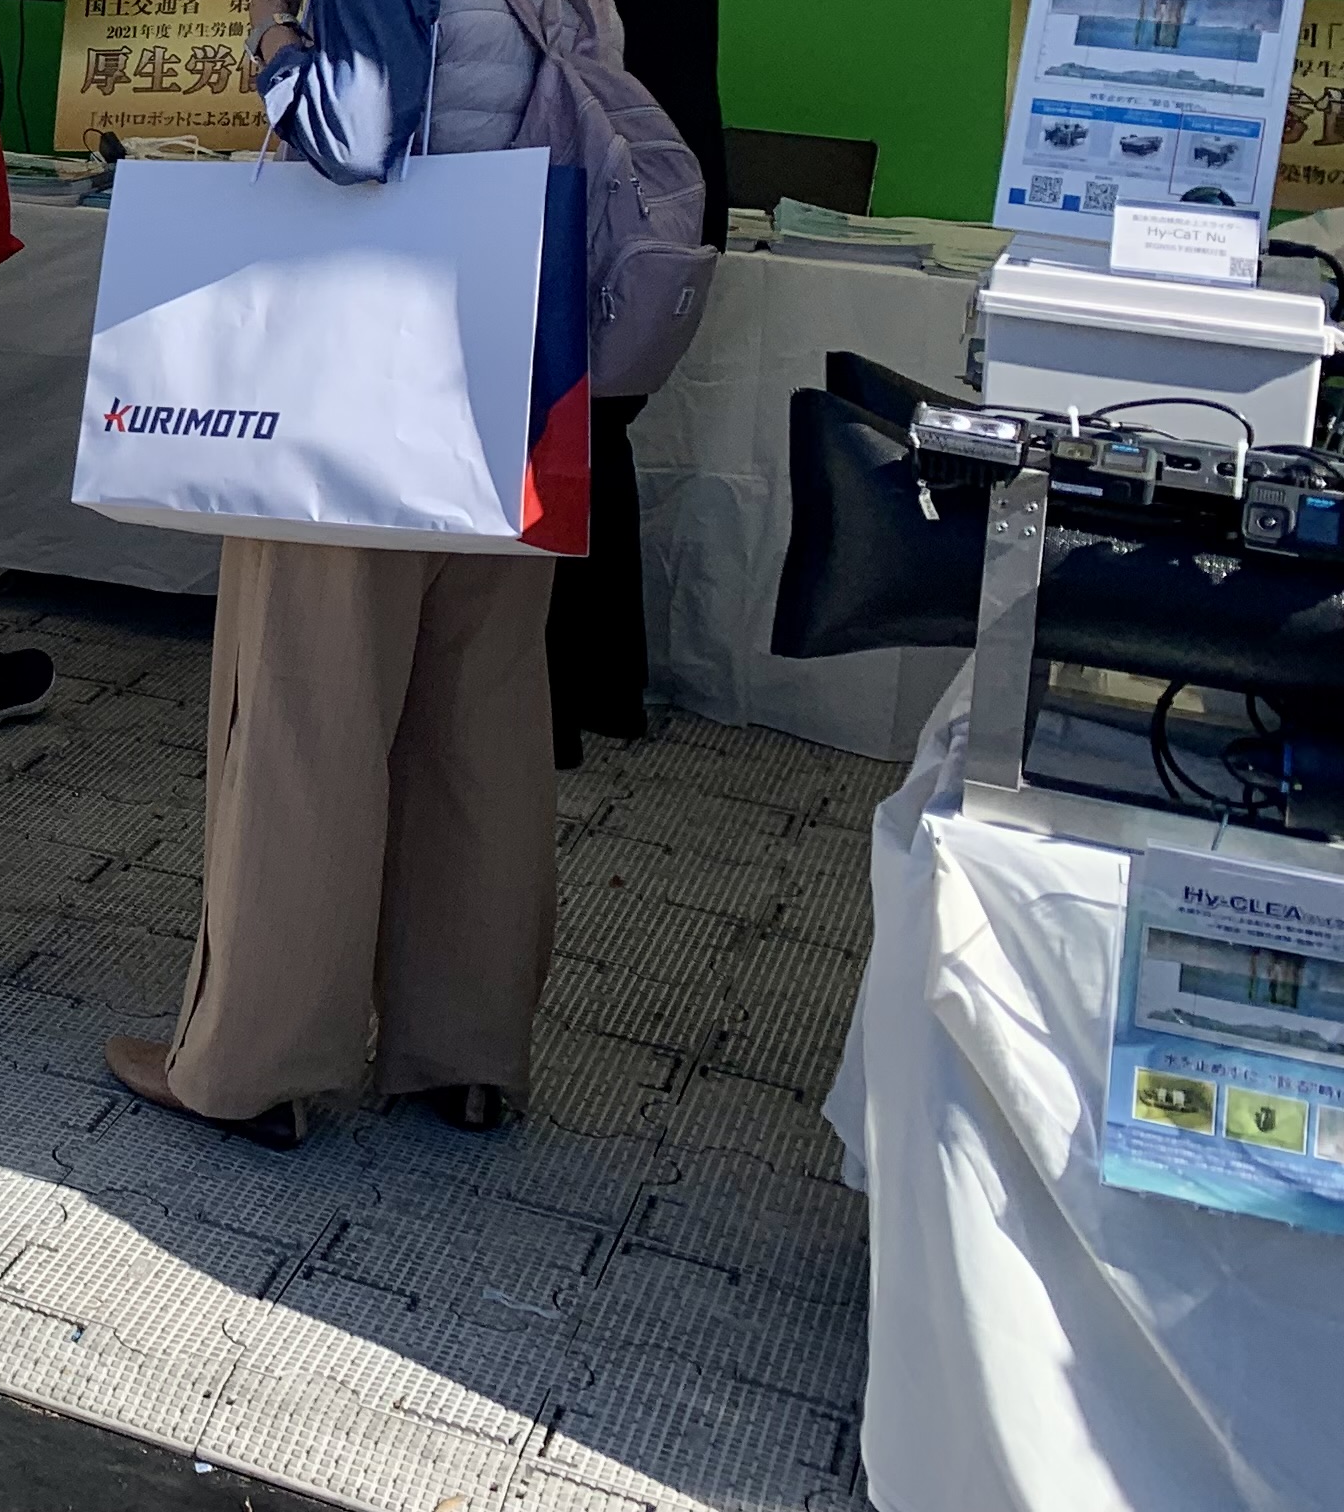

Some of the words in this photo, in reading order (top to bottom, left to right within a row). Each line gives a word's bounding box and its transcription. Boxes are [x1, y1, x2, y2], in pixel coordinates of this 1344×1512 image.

[106, 24, 172, 39] 2021年度
[1147, 226, 1200, 240] Hy-CaT
[1206, 231, 1226, 244] Nu
[103, 397, 281, 440] KURIMOTO
